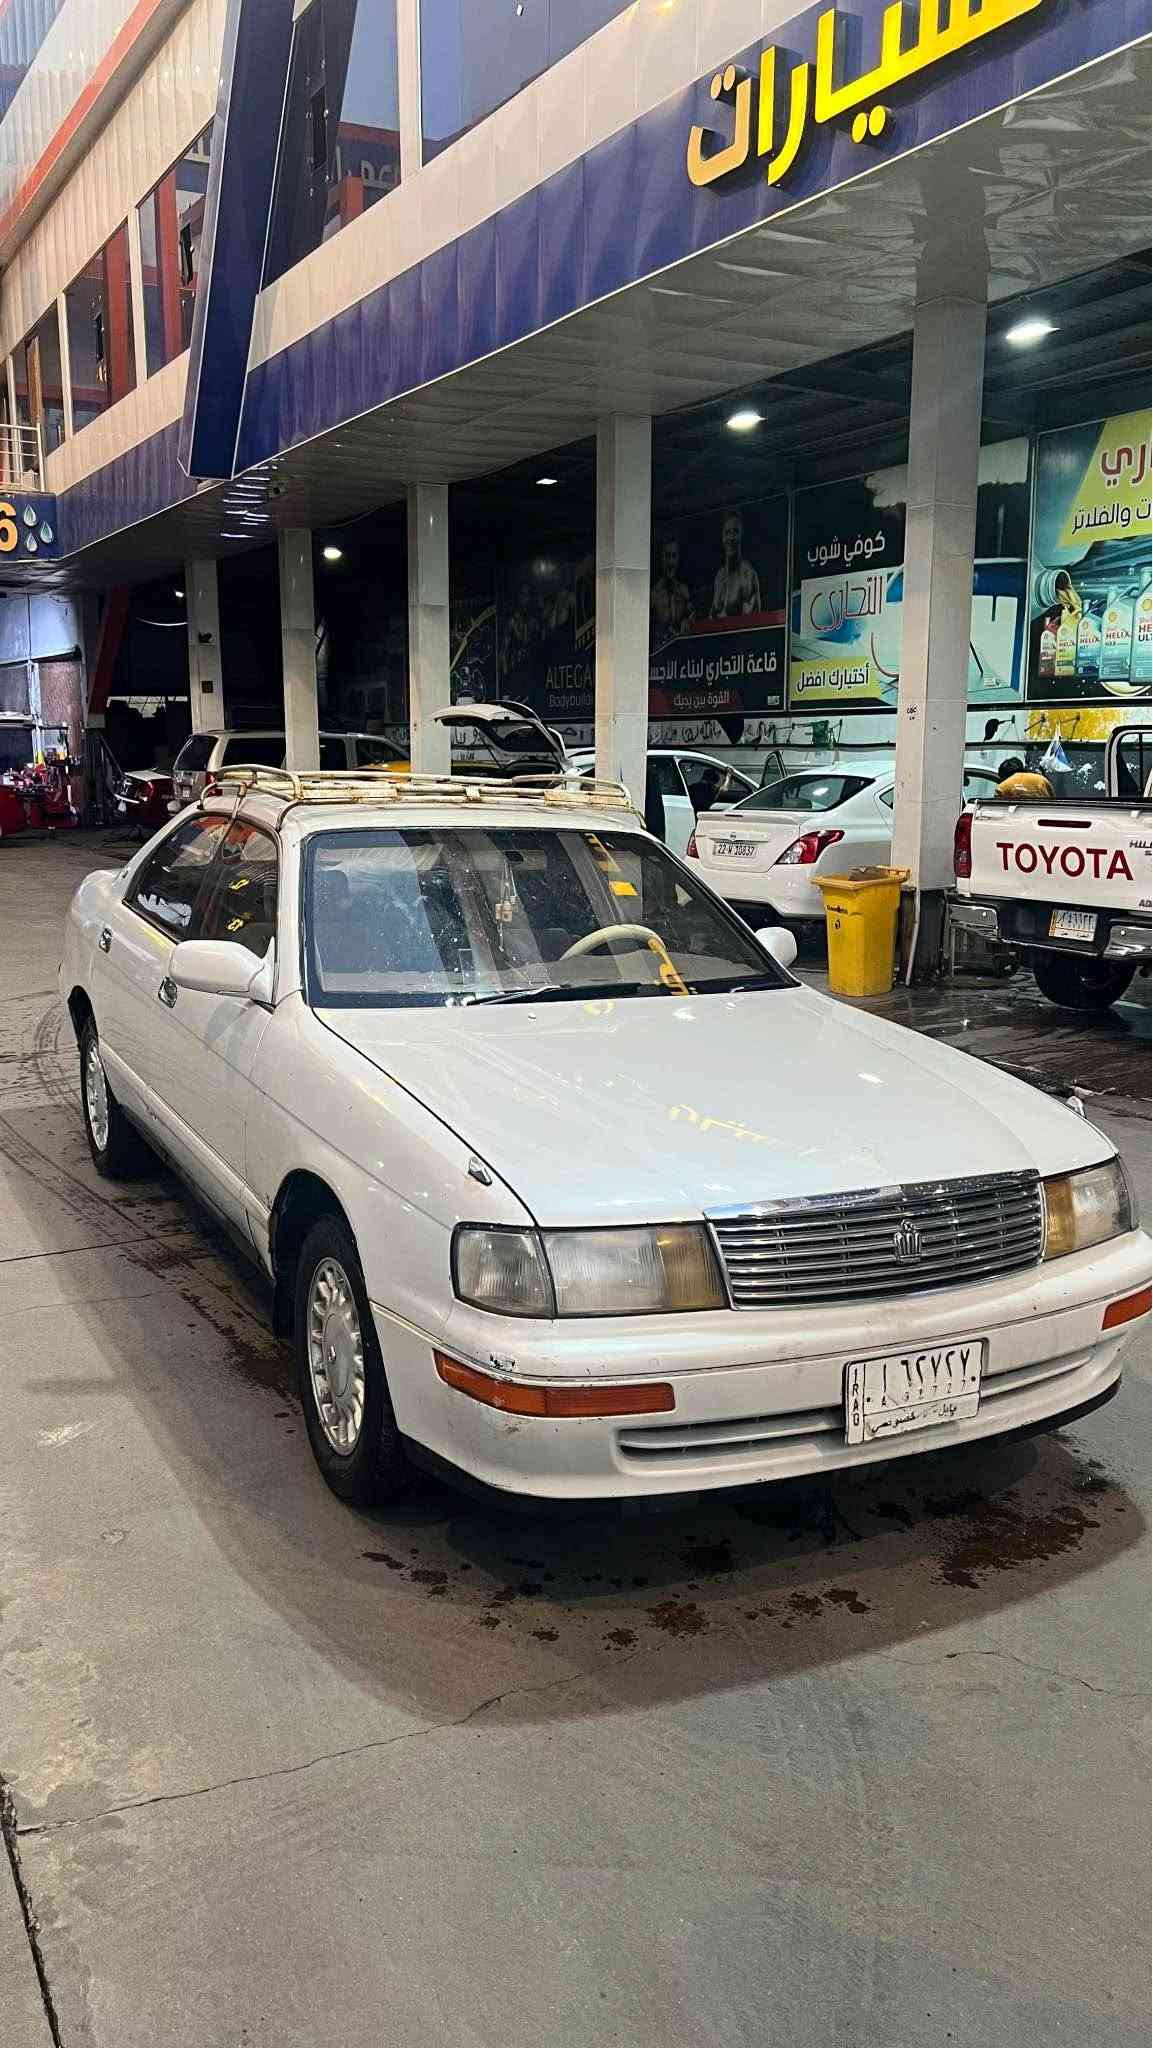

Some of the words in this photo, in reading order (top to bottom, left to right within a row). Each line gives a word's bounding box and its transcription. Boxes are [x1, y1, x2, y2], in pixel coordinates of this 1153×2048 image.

[1072, 503, 1131, 535] والفلاتر
[807, 535, 842, 567] شوب
[844, 530, 886, 568] كوفي
[680, 658, 704, 681] لبناء
[706, 654, 744, 685] التجاري
[747, 650, 777, 673] قاعة
[829, 662, 870, 691] أختيارك
[797, 669, 826, 693] افضل
[707, 690, 730, 708] القوة
[996, 842, 1134, 881] TOYOTA
[851, 1367, 860, 1427] IRAQ
